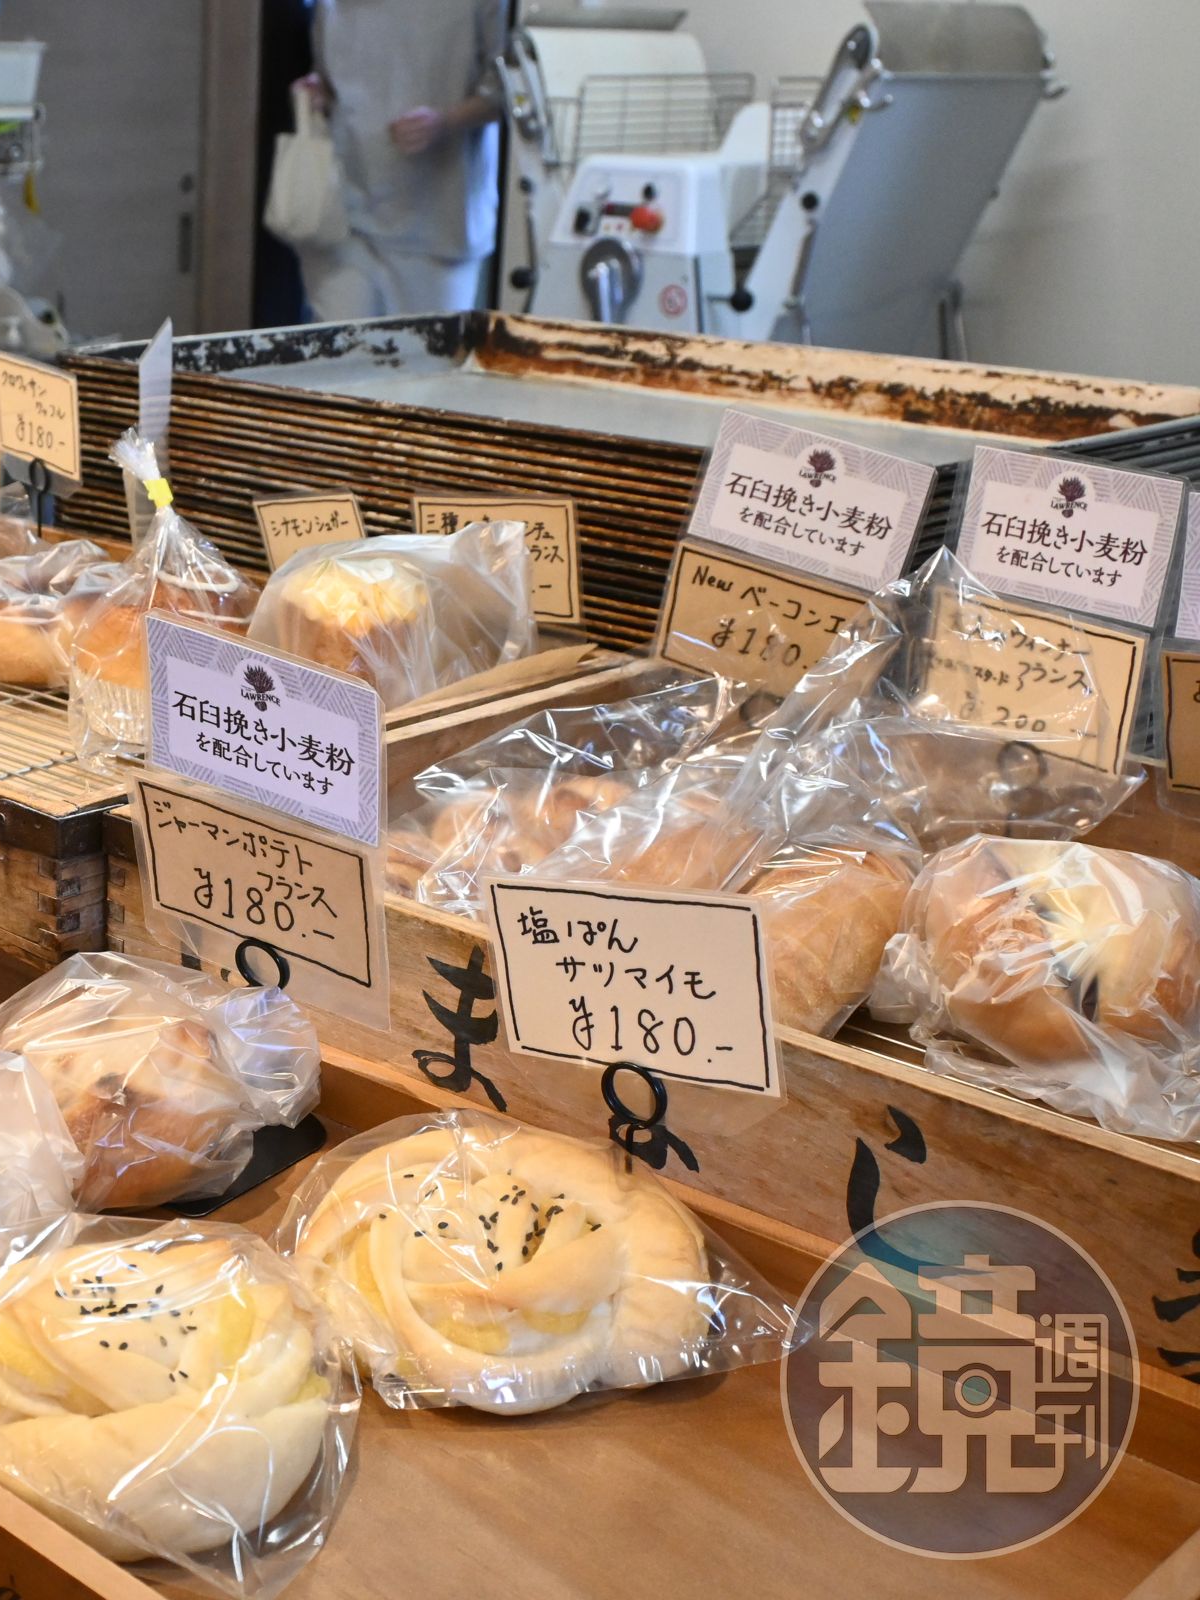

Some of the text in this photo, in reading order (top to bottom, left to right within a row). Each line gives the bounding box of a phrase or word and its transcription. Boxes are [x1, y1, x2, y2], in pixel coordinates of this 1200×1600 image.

[270, 509, 349, 538] シナモンシュガー
[725, 472, 893, 540] 石臼挽き小麦粉
[739, 506, 865, 557] を配合しています
[981, 511, 1149, 566] 石臼挽き小麦粉
[691, 565, 733, 593] New
[996, 546, 1122, 588] を配合しています
[240, 688, 281, 708] LAWRENCE
[172, 690, 355, 777] 石臼挽き小麦粉
[196, 731, 334, 796] を配合しています
[154, 800, 313, 876] ジャーマンポテト
[257, 871, 338, 919] フランス
[517, 906, 639, 953] 塩ぱん
[556, 956, 717, 1000] サツマイモ
